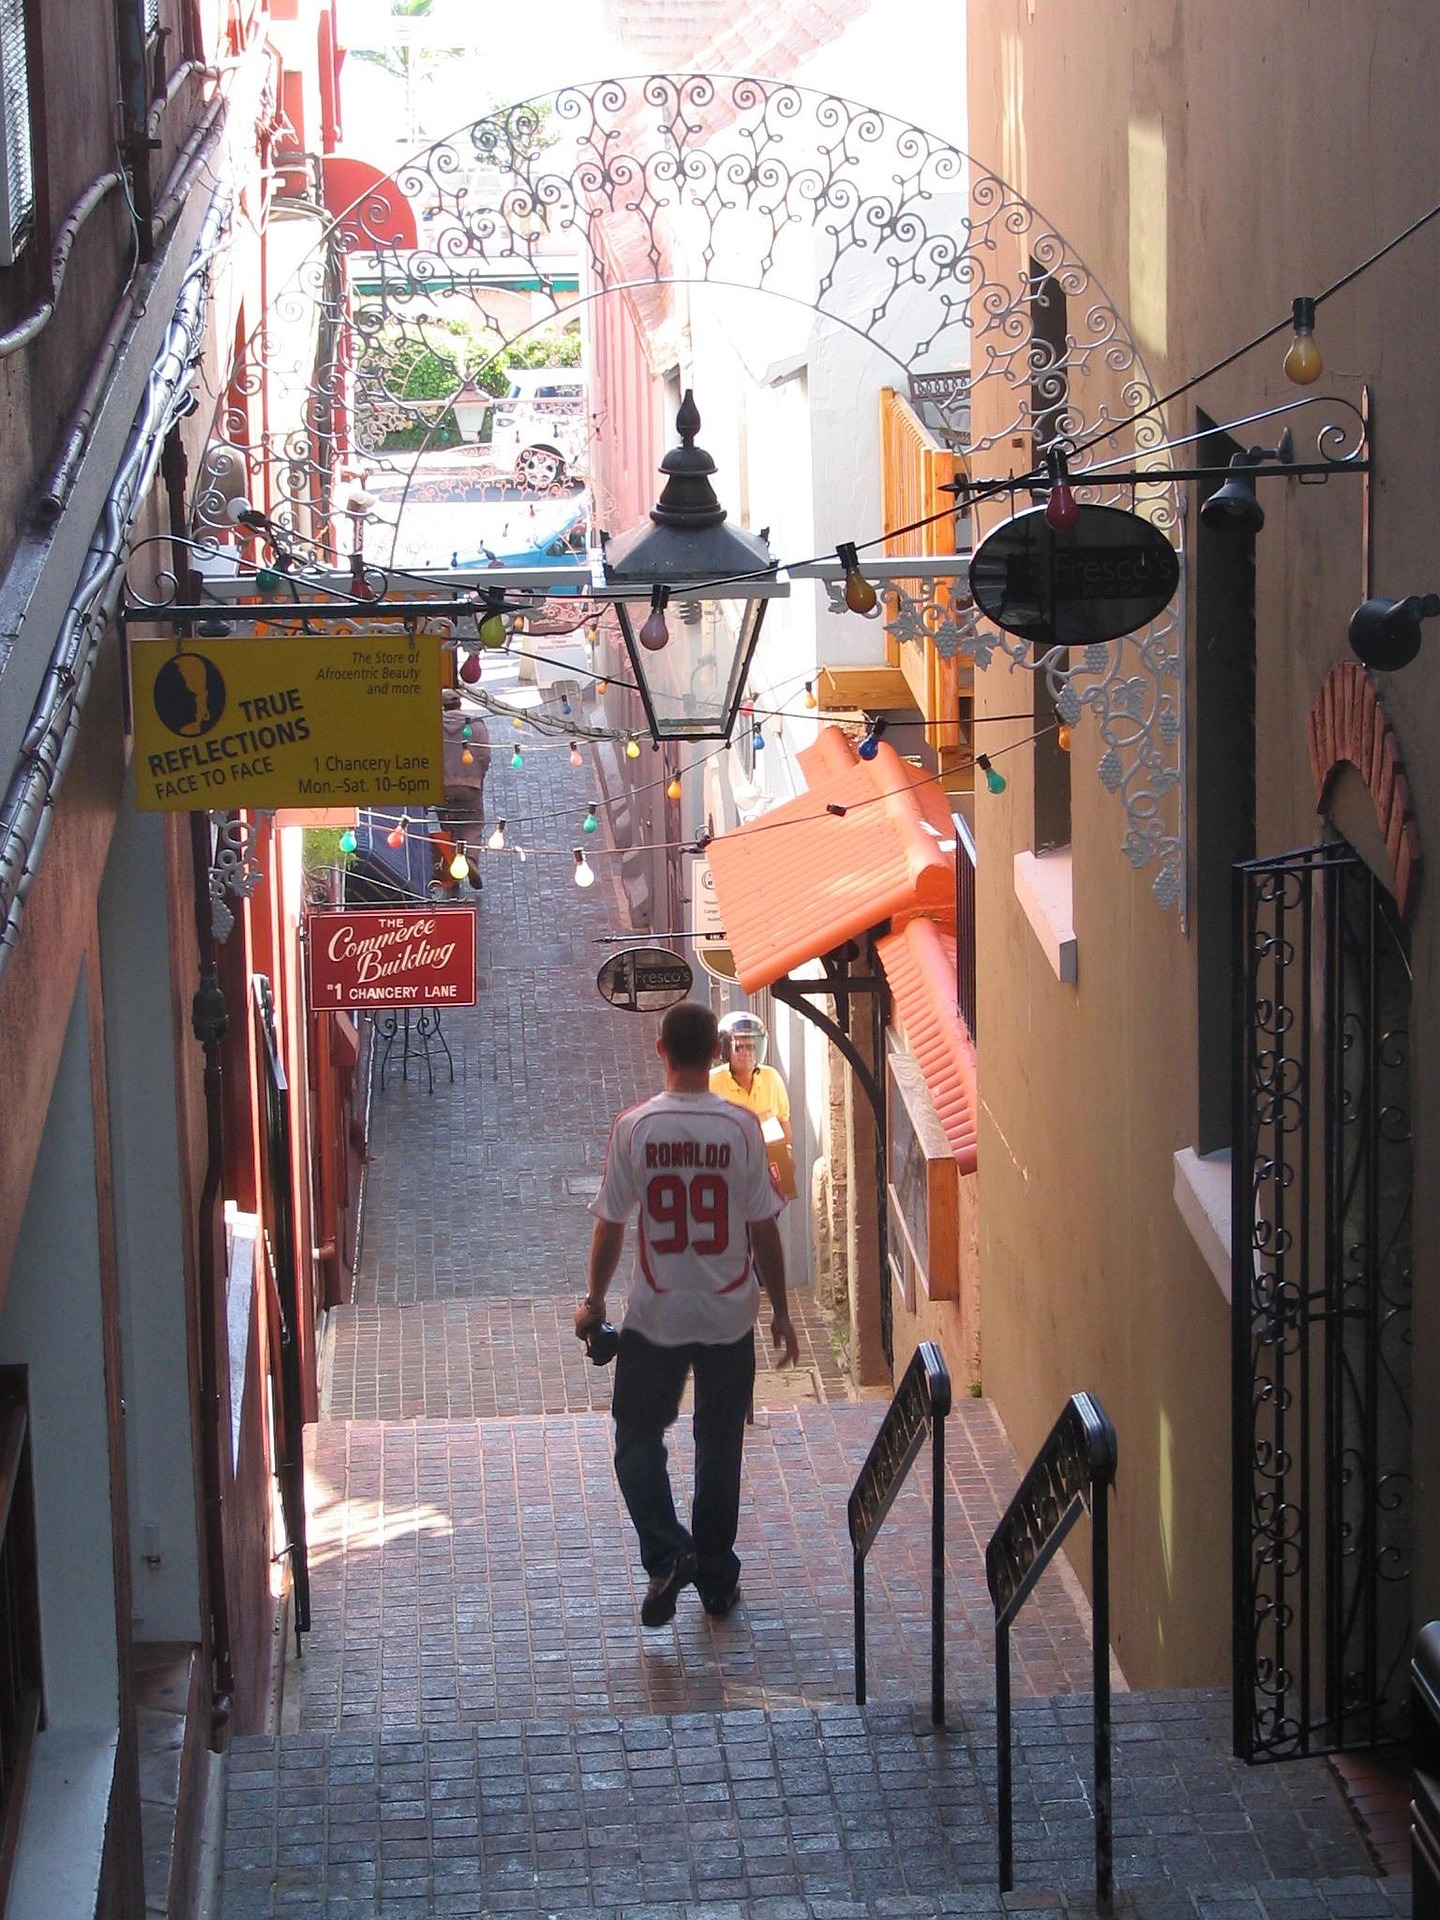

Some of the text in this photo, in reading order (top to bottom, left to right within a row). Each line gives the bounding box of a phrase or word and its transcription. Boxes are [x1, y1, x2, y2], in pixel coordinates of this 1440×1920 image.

[352, 650, 420, 664] The Store of
[316, 666, 420, 682] Afrocentric Beauty
[366, 683, 420, 695] and more
[238, 688, 304, 723] TRUE
[148, 717, 311, 777] REFLECTIONS
[313, 754, 429, 776] 1 Chancery Lane
[155, 756, 274, 800] FACE TO FACE
[378, 918, 404, 928] THE
[328, 918, 436, 962] Commerce
[357, 939, 456, 984] Building
[635, 969, 690, 984] Fresco's
[349, 986, 419, 1000] CHANCERY
[425, 985, 457, 998] LANE
[645, 1141, 731, 1169] RONALDO
[647, 1173, 729, 1256] 99
